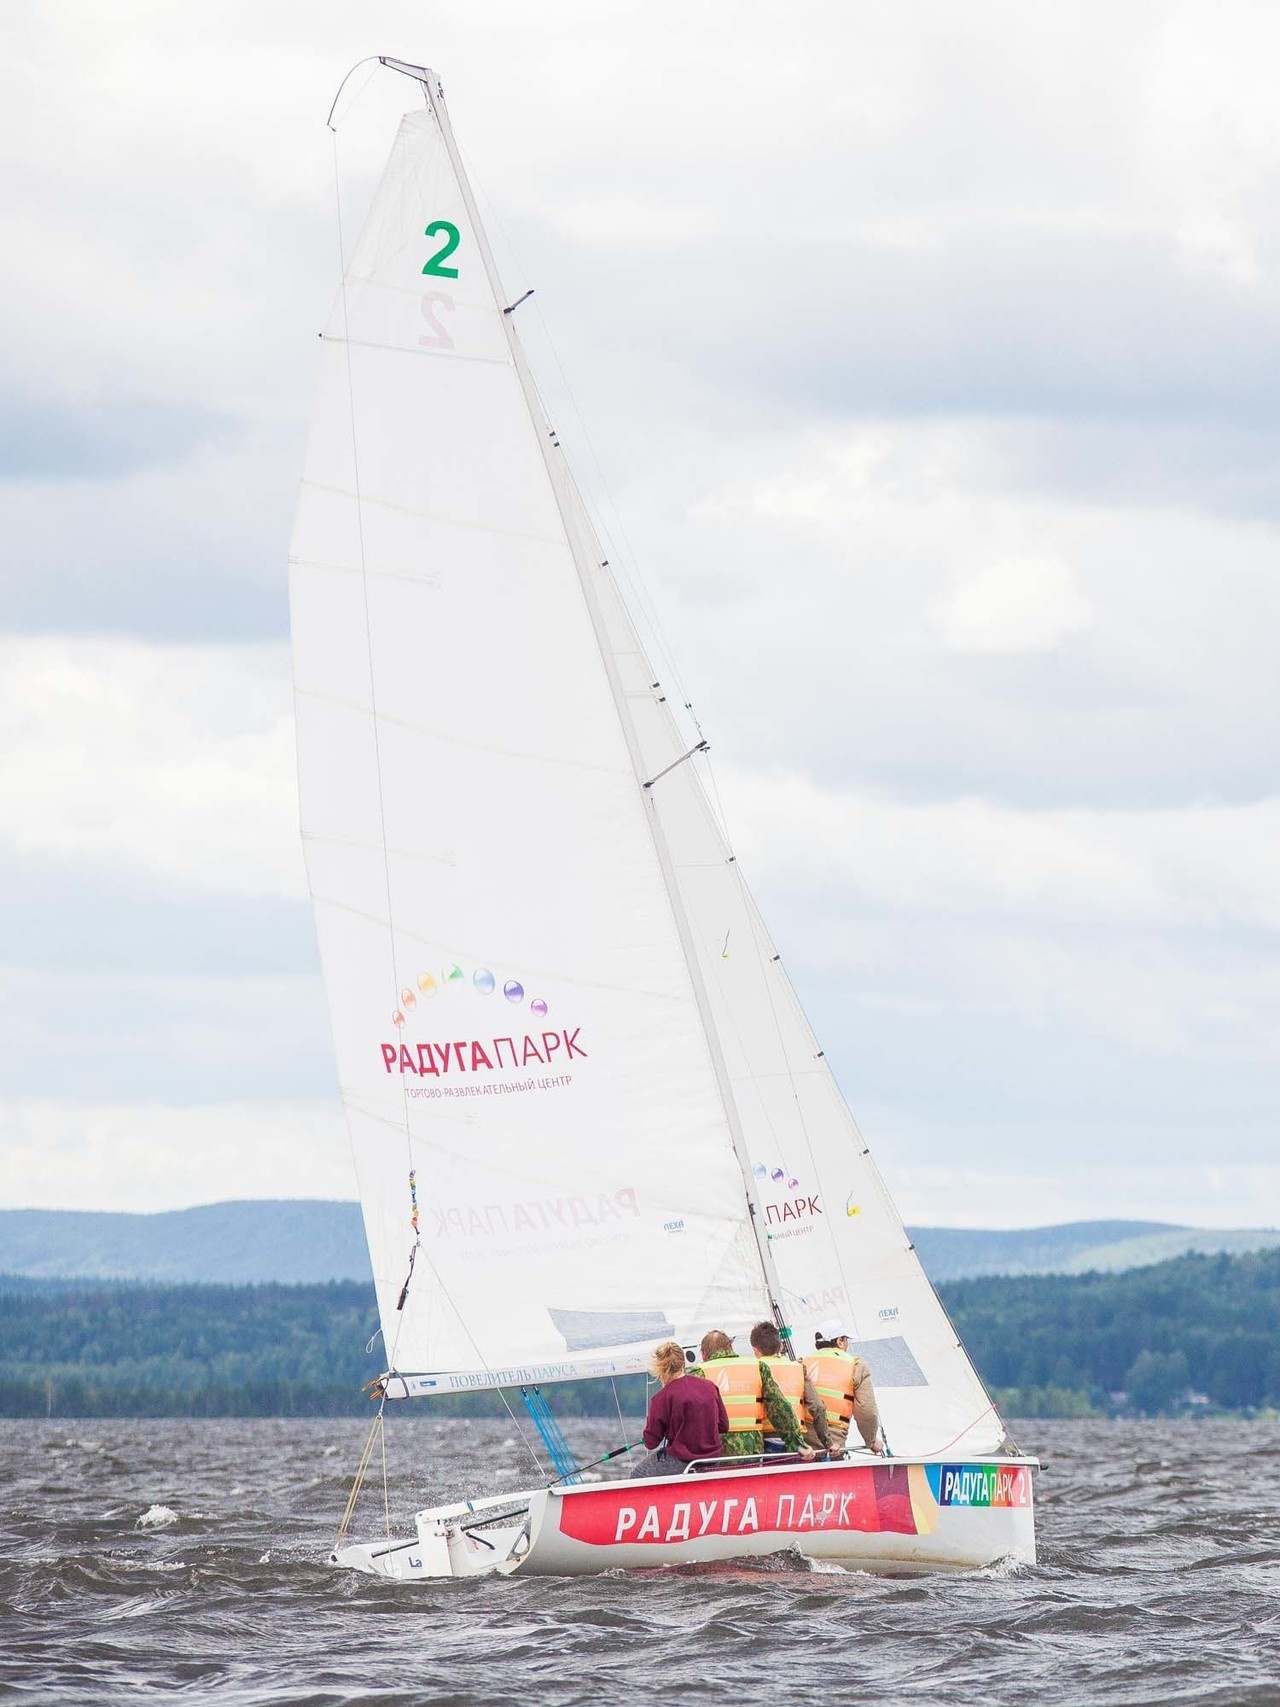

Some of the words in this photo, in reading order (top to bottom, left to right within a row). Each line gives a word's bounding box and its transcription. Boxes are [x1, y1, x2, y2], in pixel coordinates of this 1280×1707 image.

[422, 220, 460, 279] 2
[381, 1027, 588, 1077] РАДУГАПАРК
[404, 1079, 536, 1100] ТОРГОВО-РАЗВЛЕКАТЕЛЬНЫЙ
[538, 1075, 572, 1090] ЦЕНТР
[449, 1368, 531, 1388] ПОВЕЛИТЕЛЬ
[532, 1364, 578, 1380] ПАРУСА
[1018, 1472, 1027, 1504] 2
[614, 1497, 759, 1541] РАДУГА
[775, 1492, 854, 1527] ПАРК
